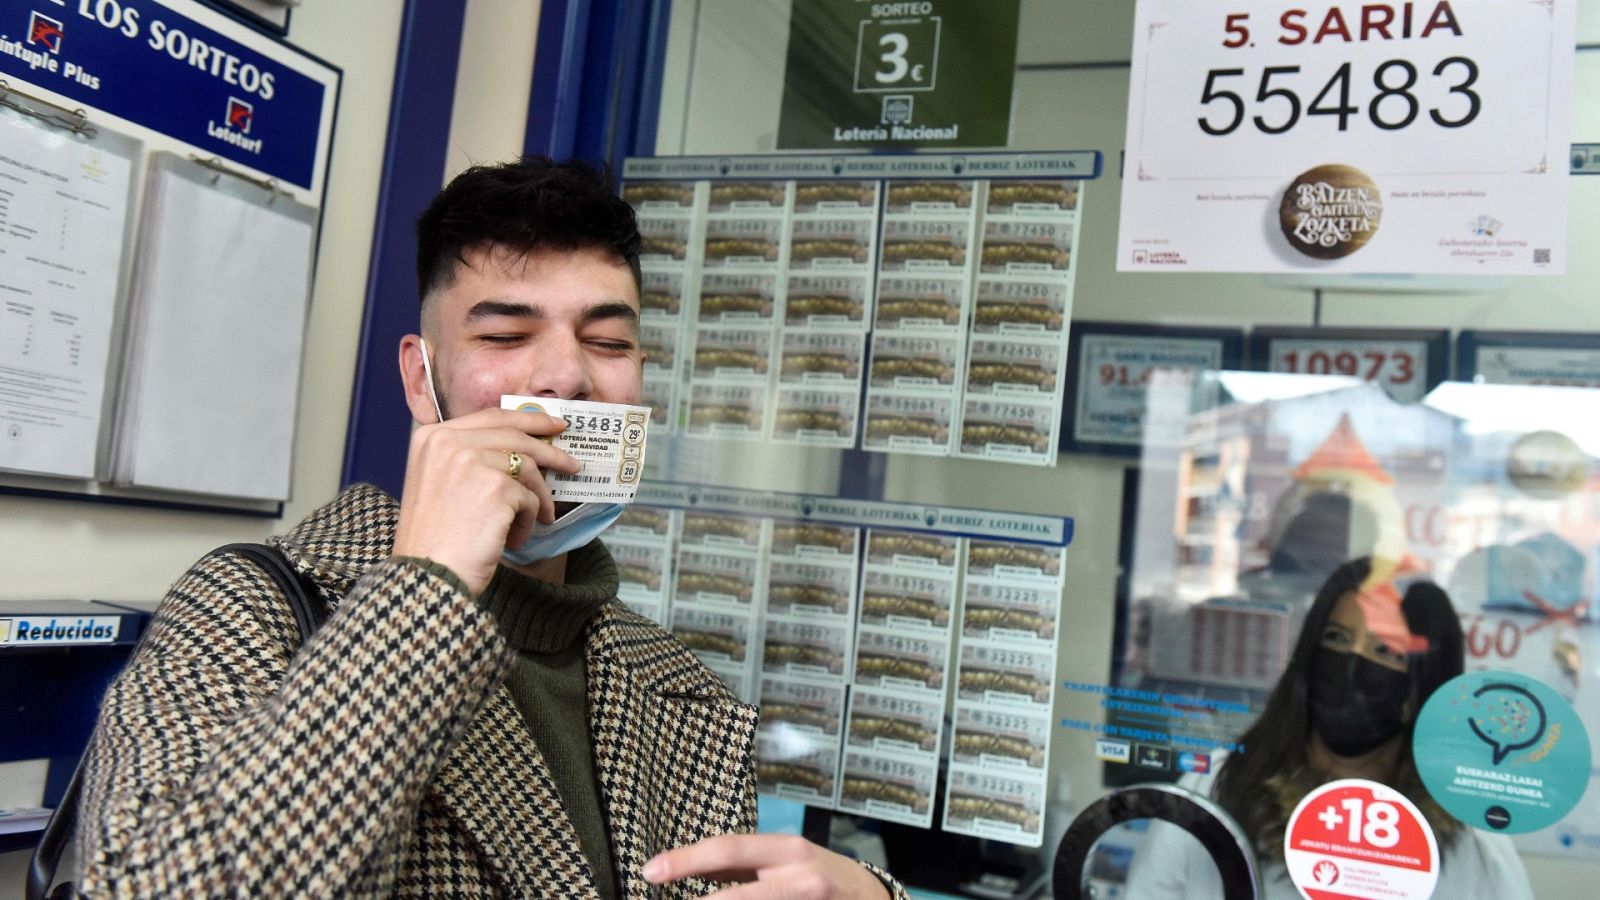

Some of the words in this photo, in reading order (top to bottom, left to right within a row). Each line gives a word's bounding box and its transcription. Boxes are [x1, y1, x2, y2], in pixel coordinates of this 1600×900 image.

[871, 2, 932, 17] SORTEO
[1278, 0, 1463, 45] SARIA
[79, 0, 139, 38] LOS
[148, 20, 275, 101] SORTEOS
[63, 61, 101, 91] Plus
[1197, 56, 1482, 136] 55483
[207, 120, 263, 154] Lototurf
[891, 124, 958, 140] Nacional
[891, 161, 948, 171] LOTERIAK
[968, 161, 1010, 170] BERRIZ
[1015, 159, 1076, 170] LOTERIAK
[1284, 351, 1415, 385] 10973
[563, 414, 623, 433] 55483
[560, 434, 587, 443] LOTERÍA
[588, 436, 619, 445] NACIONAL
[581, 443, 608, 451] NAVIDAD
[624, 467, 634, 476] 20
[818, 503, 857, 515] BERRIZ
[862, 508, 921, 522] LOTERIAK
[940, 515, 985, 527] BERRIZ
[989, 520, 1051, 534] LOTERIAK
[17, 619, 113, 640] Reducidas
[1102, 745, 1125, 757] VISA
[1456, 765, 1511, 783] EUSKARAZ
[1512, 774, 1543, 788] LASAI
[1454, 776, 1504, 793] ARITZEKO
[1506, 785, 1544, 800] GUNEA
[1318, 797, 1400, 849] +18
